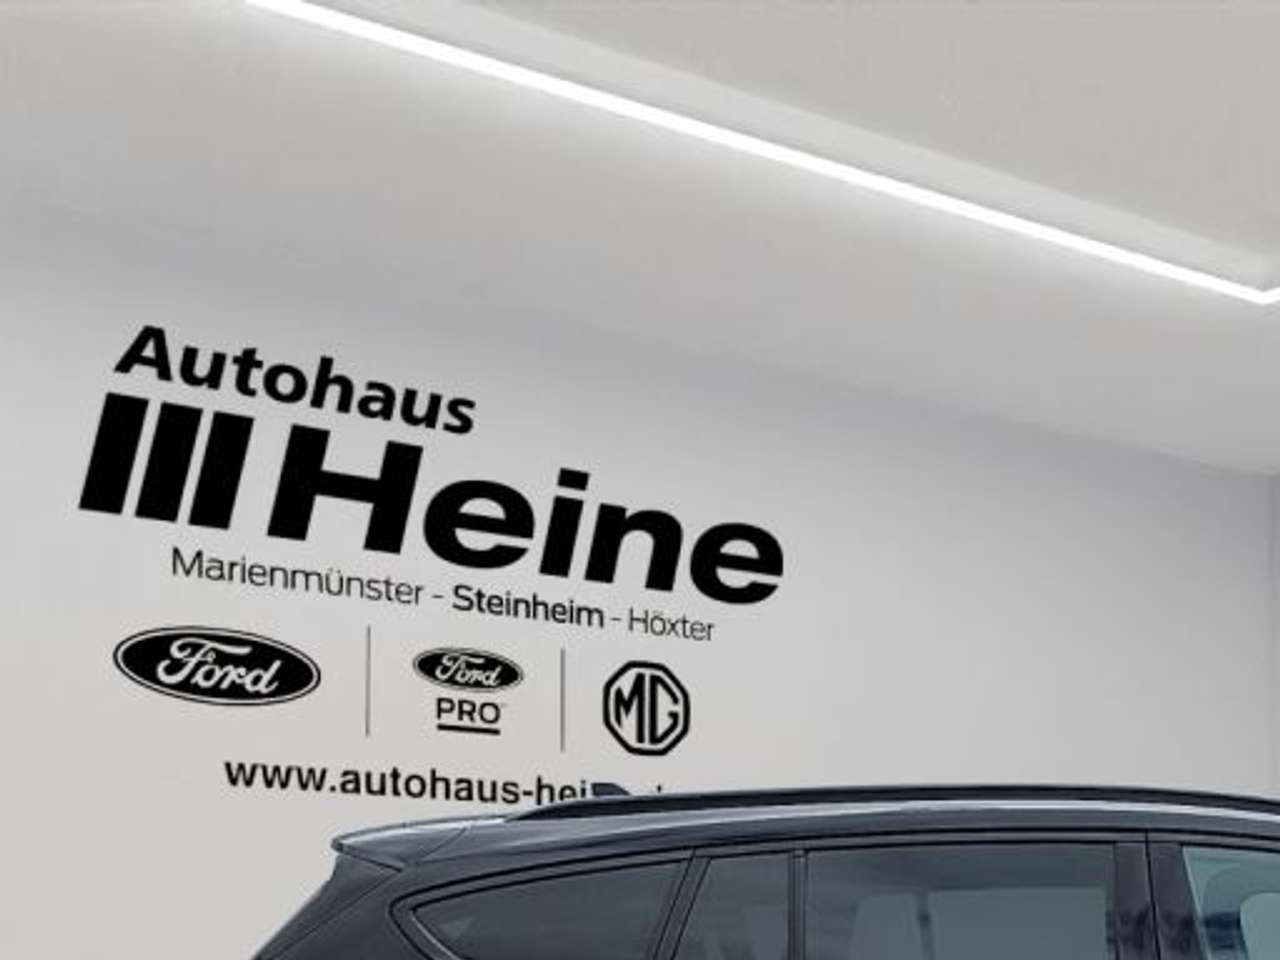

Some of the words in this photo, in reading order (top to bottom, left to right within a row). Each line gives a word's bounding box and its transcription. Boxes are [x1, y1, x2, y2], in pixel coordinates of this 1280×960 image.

[113, 324, 477, 435] Autohaus
[266, 423, 784, 605] Heine
[172, 546, 423, 605] Marienmünster
[452, 584, 604, 629] Steinheim
[628, 607, 715, 641] Höxter
[156, 637, 281, 694] Ford
[435, 654, 502, 686] Ford
[436, 697, 501, 724] PRO
[613, 671, 681, 746] MG
[224, 761, 662, 807] www.autohaus-hei
